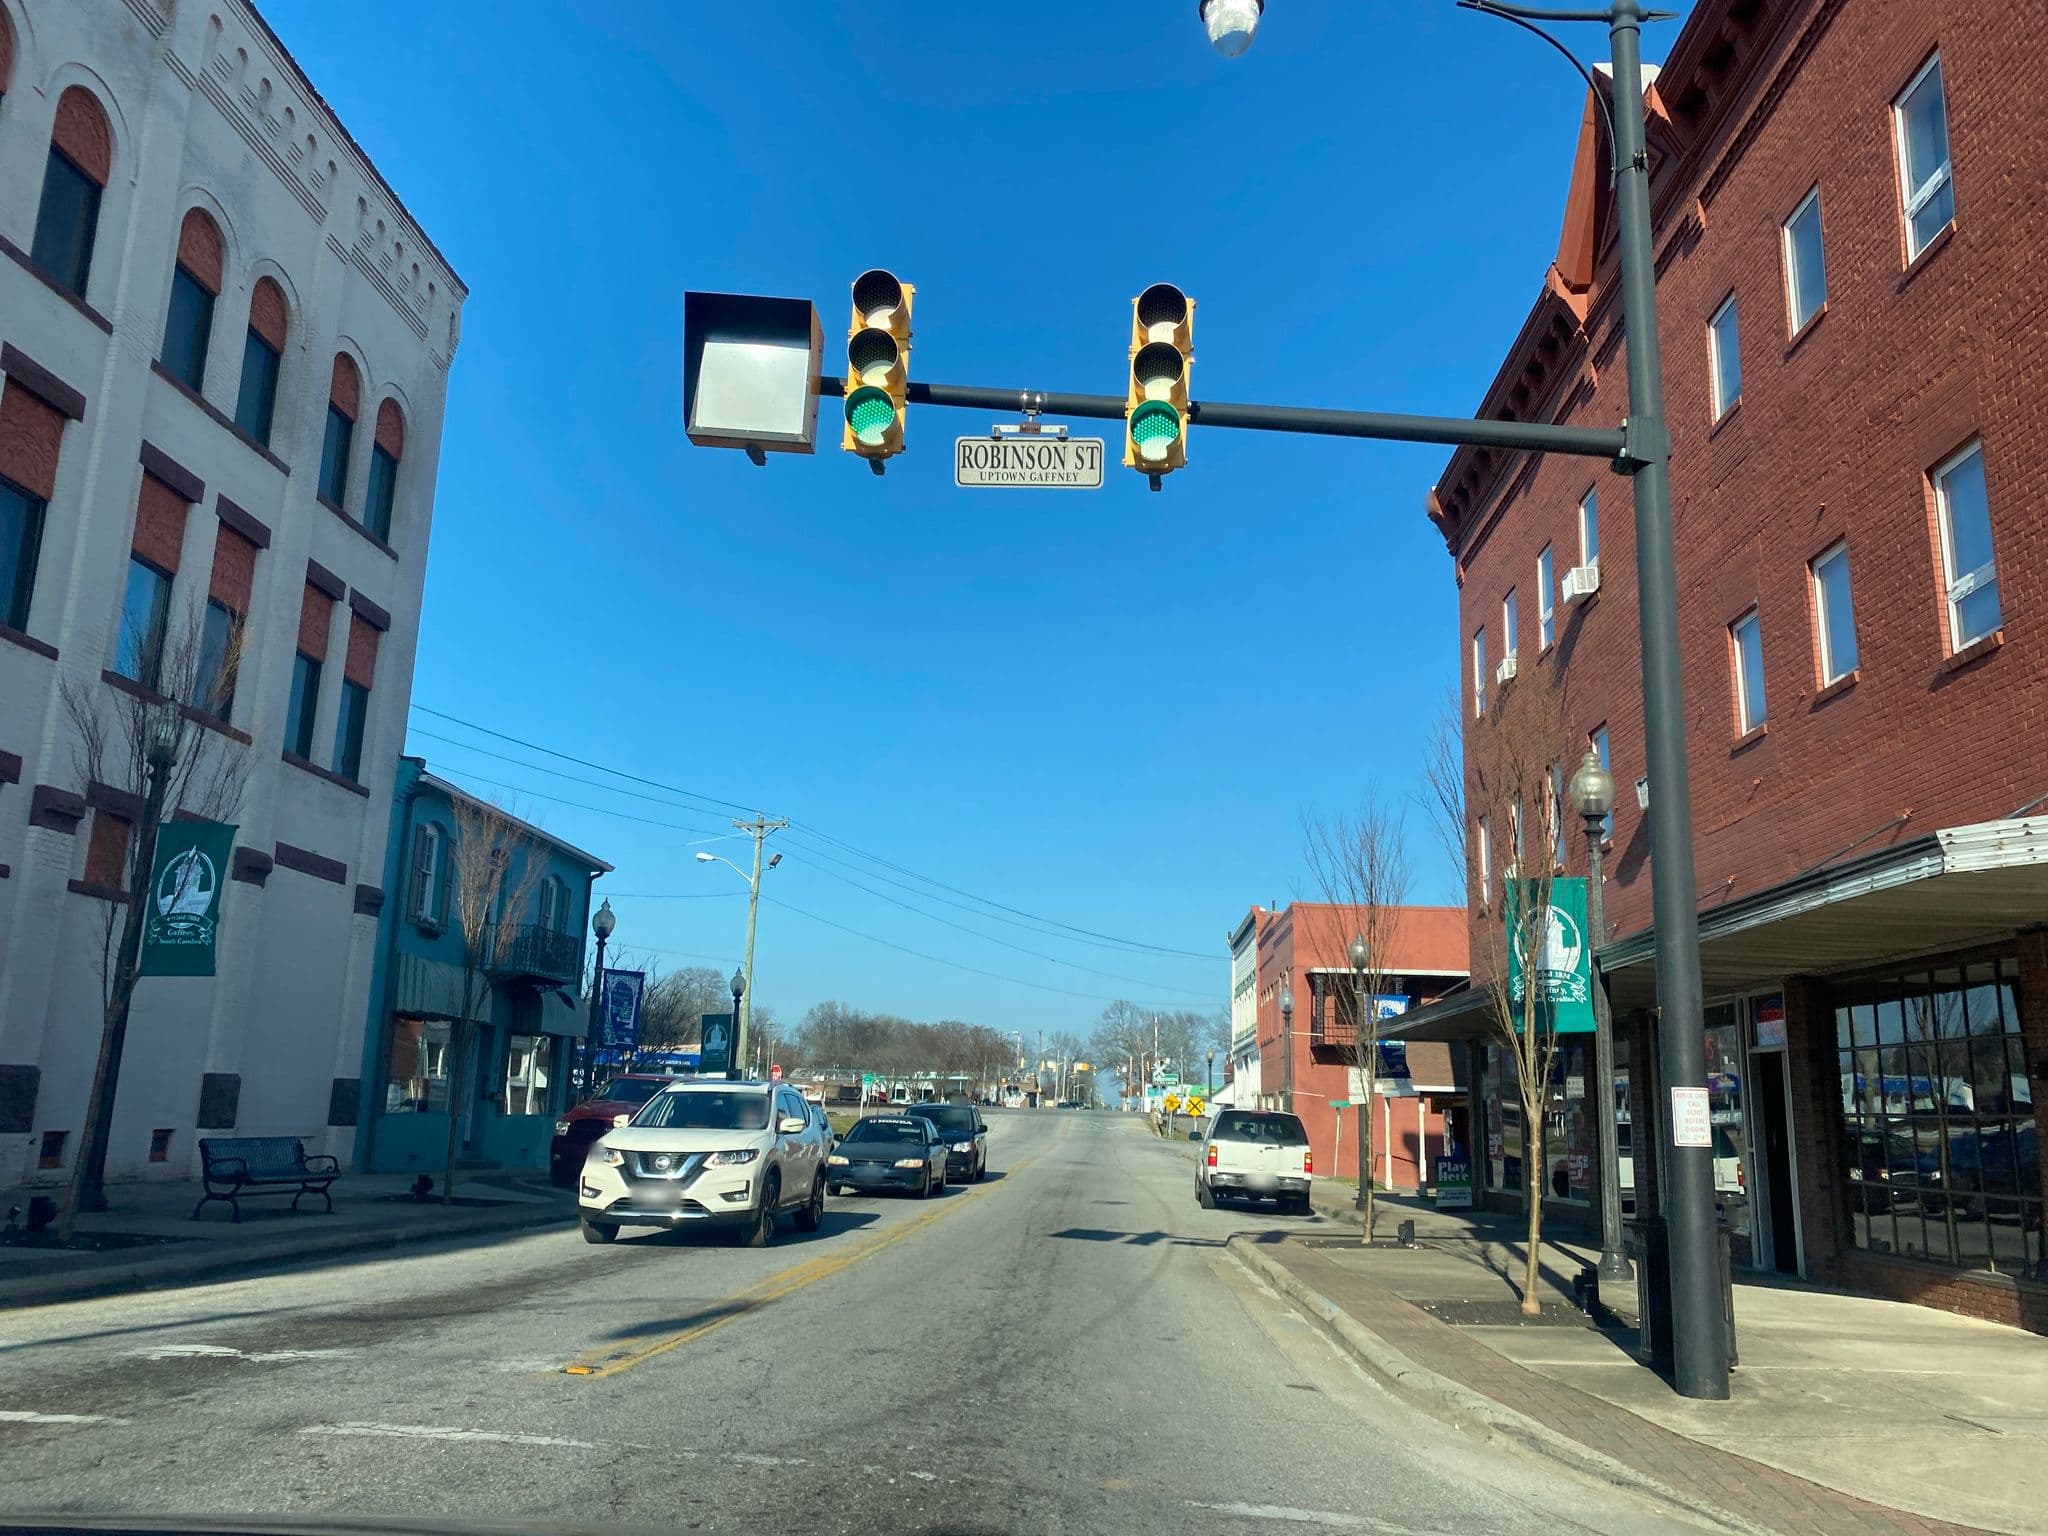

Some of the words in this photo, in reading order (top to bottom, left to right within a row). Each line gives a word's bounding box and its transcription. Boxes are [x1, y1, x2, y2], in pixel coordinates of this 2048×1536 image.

[961, 445, 1066, 470] ROBINSON
[1074, 446, 1099, 470] ST
[980, 472, 1025, 481] UPTOWN
[1030, 472, 1079, 481] GAFFNEY
[1439, 1162, 1466, 1173] Play
[1439, 1172, 1469, 1181] Here
